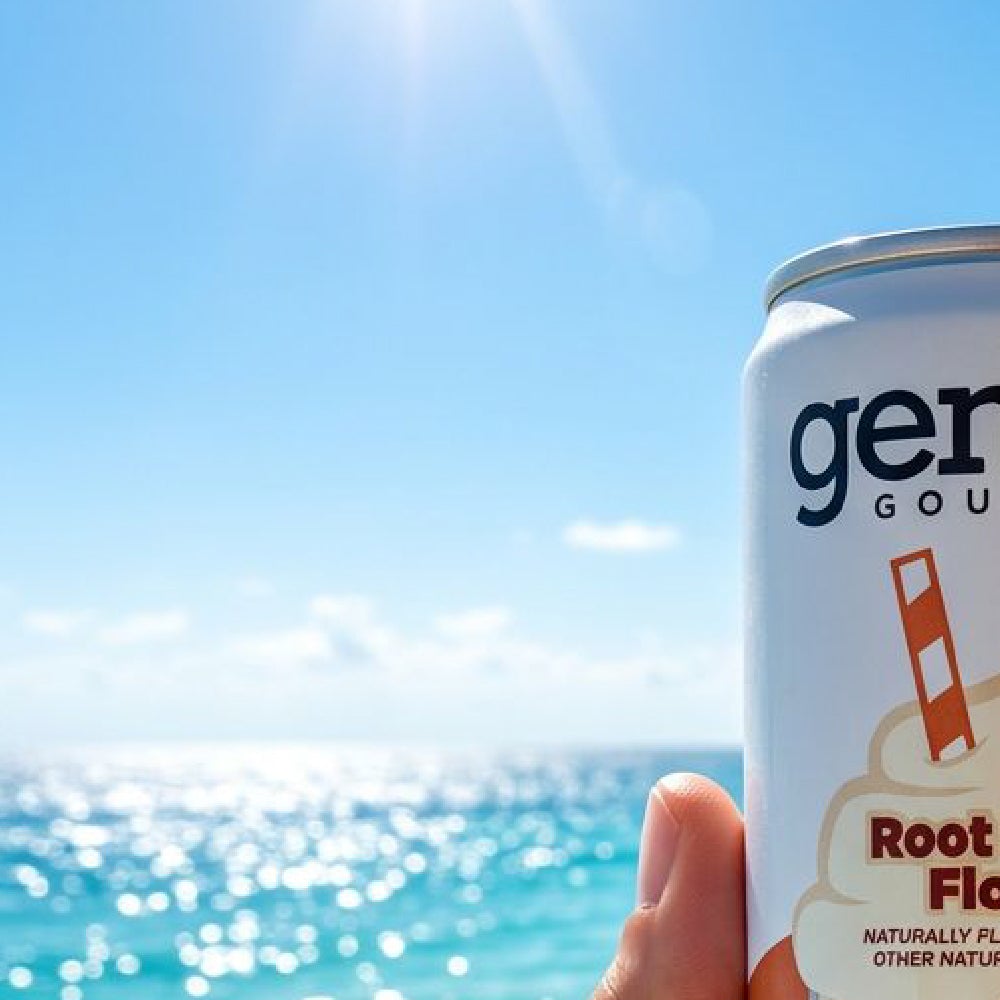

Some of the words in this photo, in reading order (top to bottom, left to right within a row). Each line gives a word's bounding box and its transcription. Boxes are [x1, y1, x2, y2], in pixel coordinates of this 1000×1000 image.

[870, 816, 993, 859] Root
[863, 928, 972, 944] NATURALLY
[873, 950, 933, 967] OTHER
